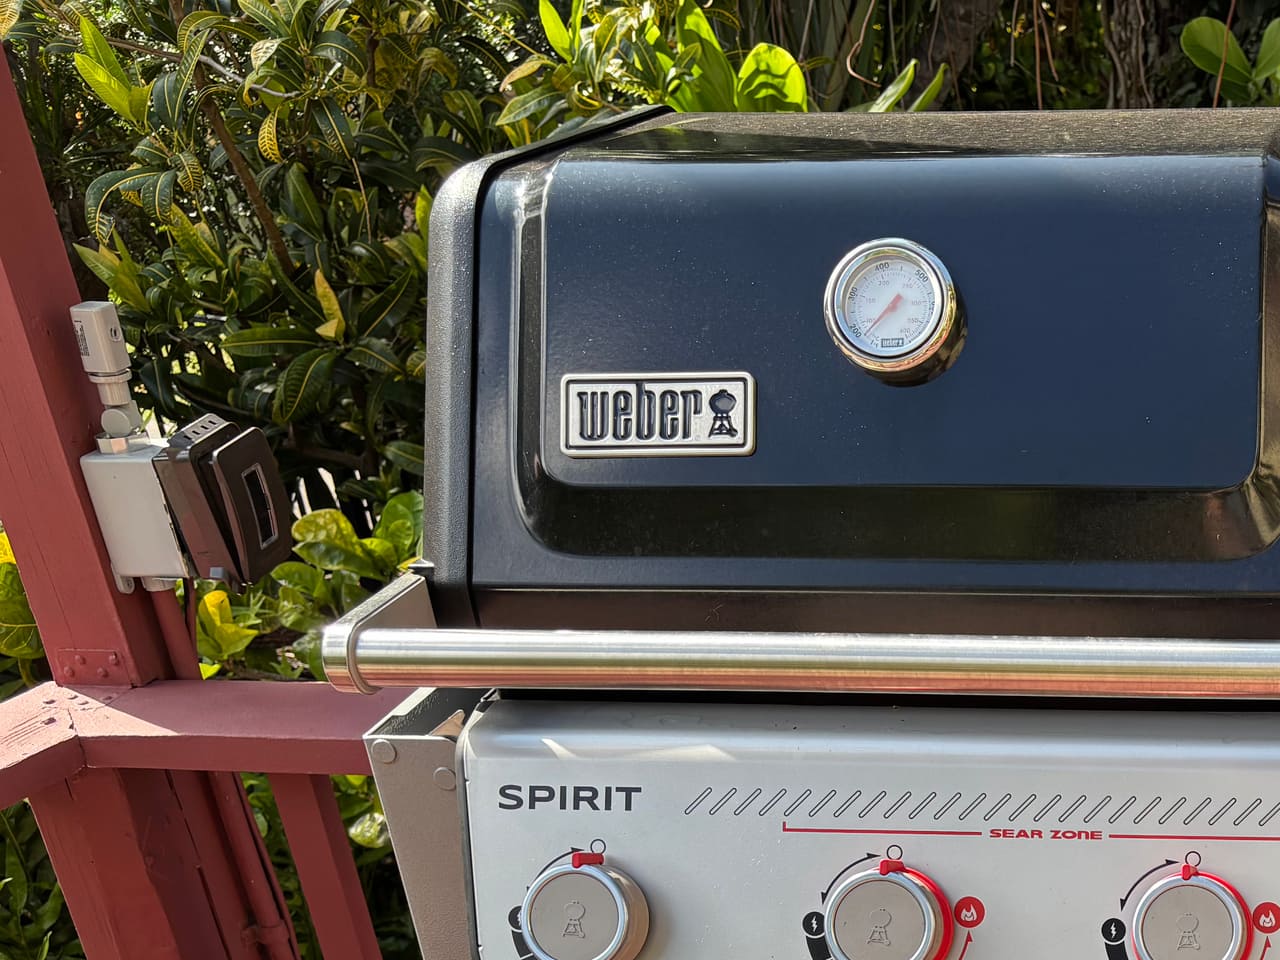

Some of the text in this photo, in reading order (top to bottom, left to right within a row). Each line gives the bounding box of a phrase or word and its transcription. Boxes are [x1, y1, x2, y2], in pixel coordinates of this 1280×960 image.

[874, 262, 890, 272] 400
[914, 269, 929, 283] 500
[848, 286, 858, 301] 300
[850, 323, 862, 338] 200
[576, 381, 703, 441] weber
[498, 784, 642, 811] SPIRIT
[989, 828, 1103, 840] SEAR ZONE
